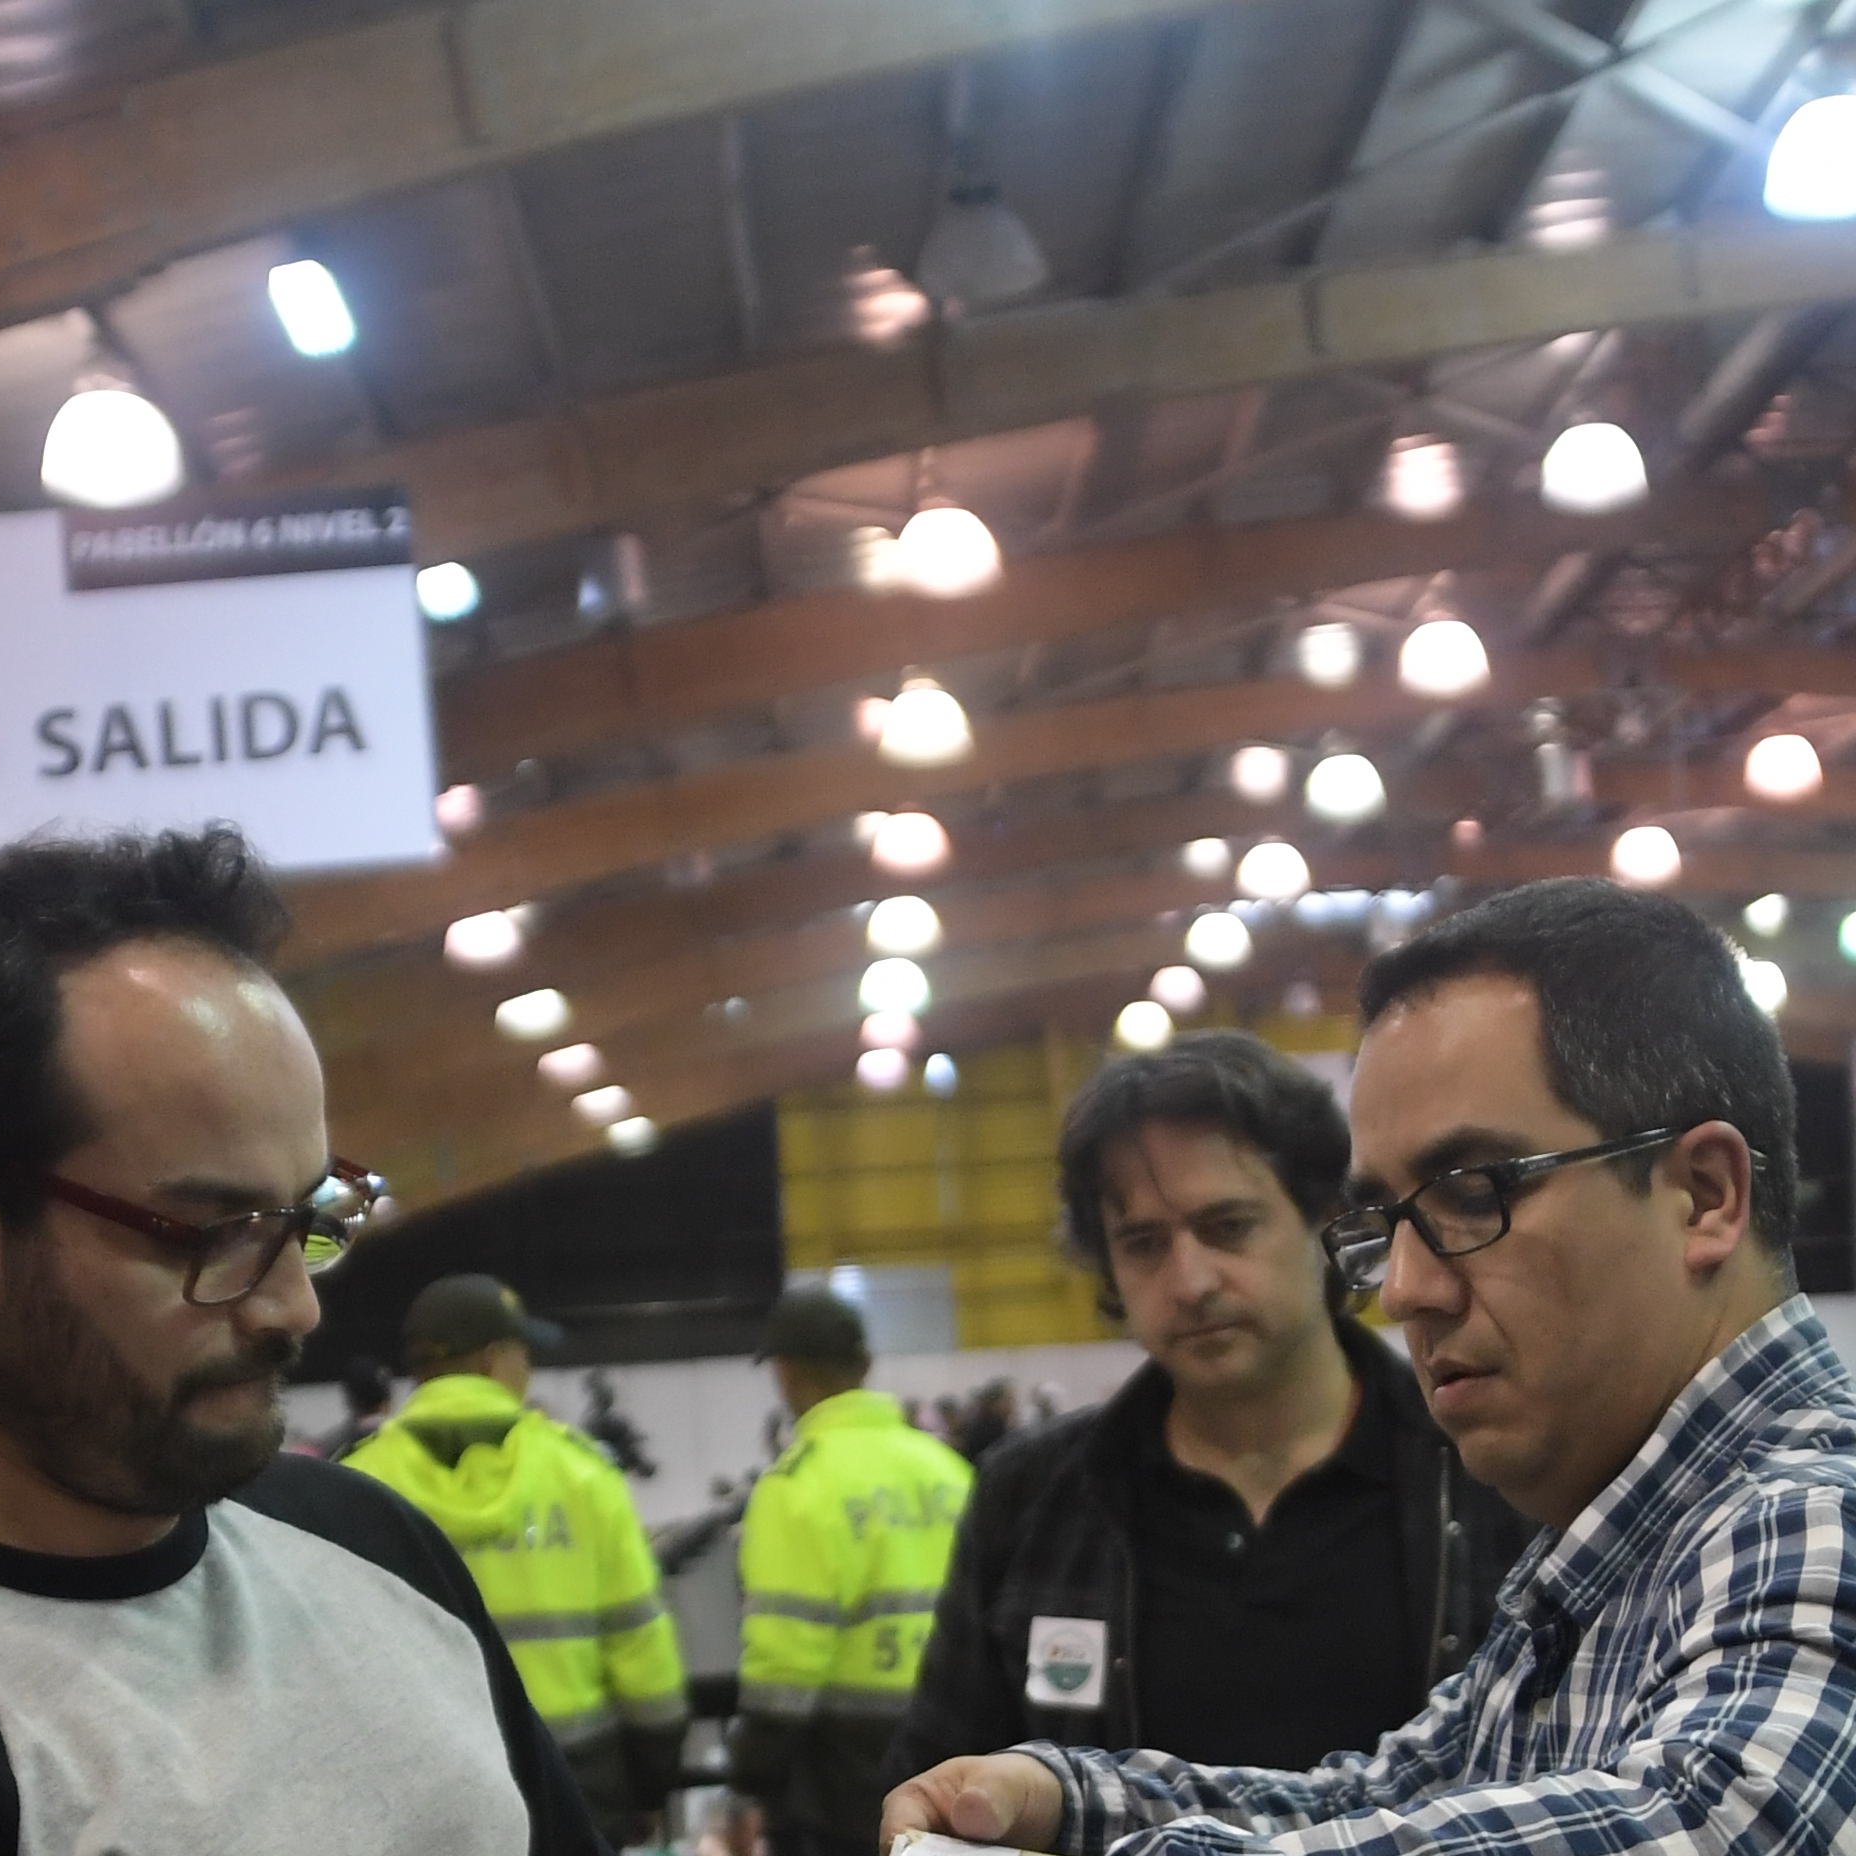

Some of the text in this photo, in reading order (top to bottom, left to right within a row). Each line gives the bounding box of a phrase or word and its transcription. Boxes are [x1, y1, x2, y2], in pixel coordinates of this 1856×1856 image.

[71, 505, 408, 561] PABELLÓN 6 NIVEL 2
[35, 687, 366, 778] SALIDA
